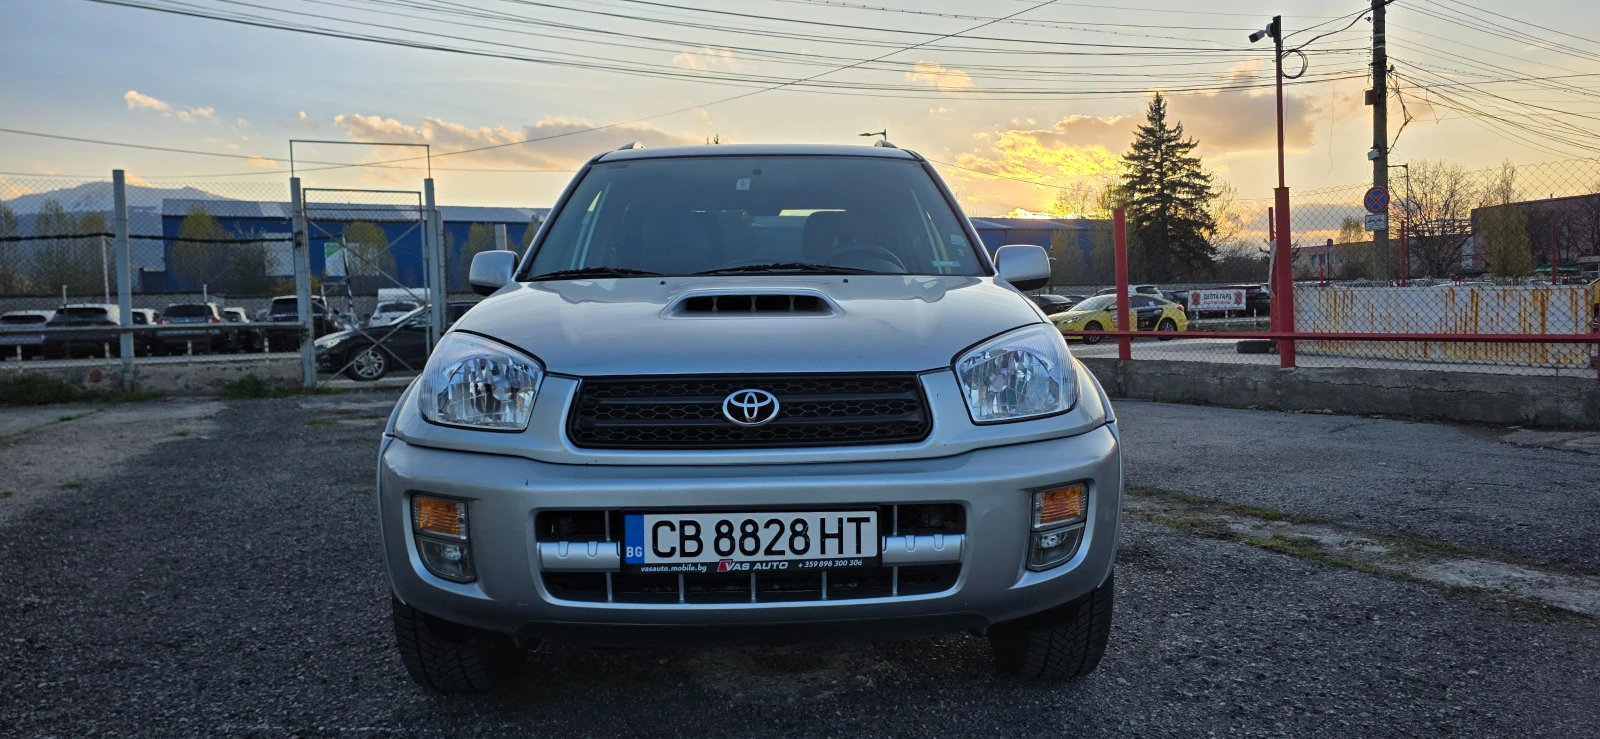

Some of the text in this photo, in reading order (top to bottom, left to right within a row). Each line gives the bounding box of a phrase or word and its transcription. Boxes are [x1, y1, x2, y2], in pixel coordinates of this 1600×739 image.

[652, 516, 871, 558] CB 8828 HT
[626, 546, 643, 557] BG
[640, 564, 707, 572] vasauto.mobile.bg
[724, 561, 788, 571] VAS AUTO
